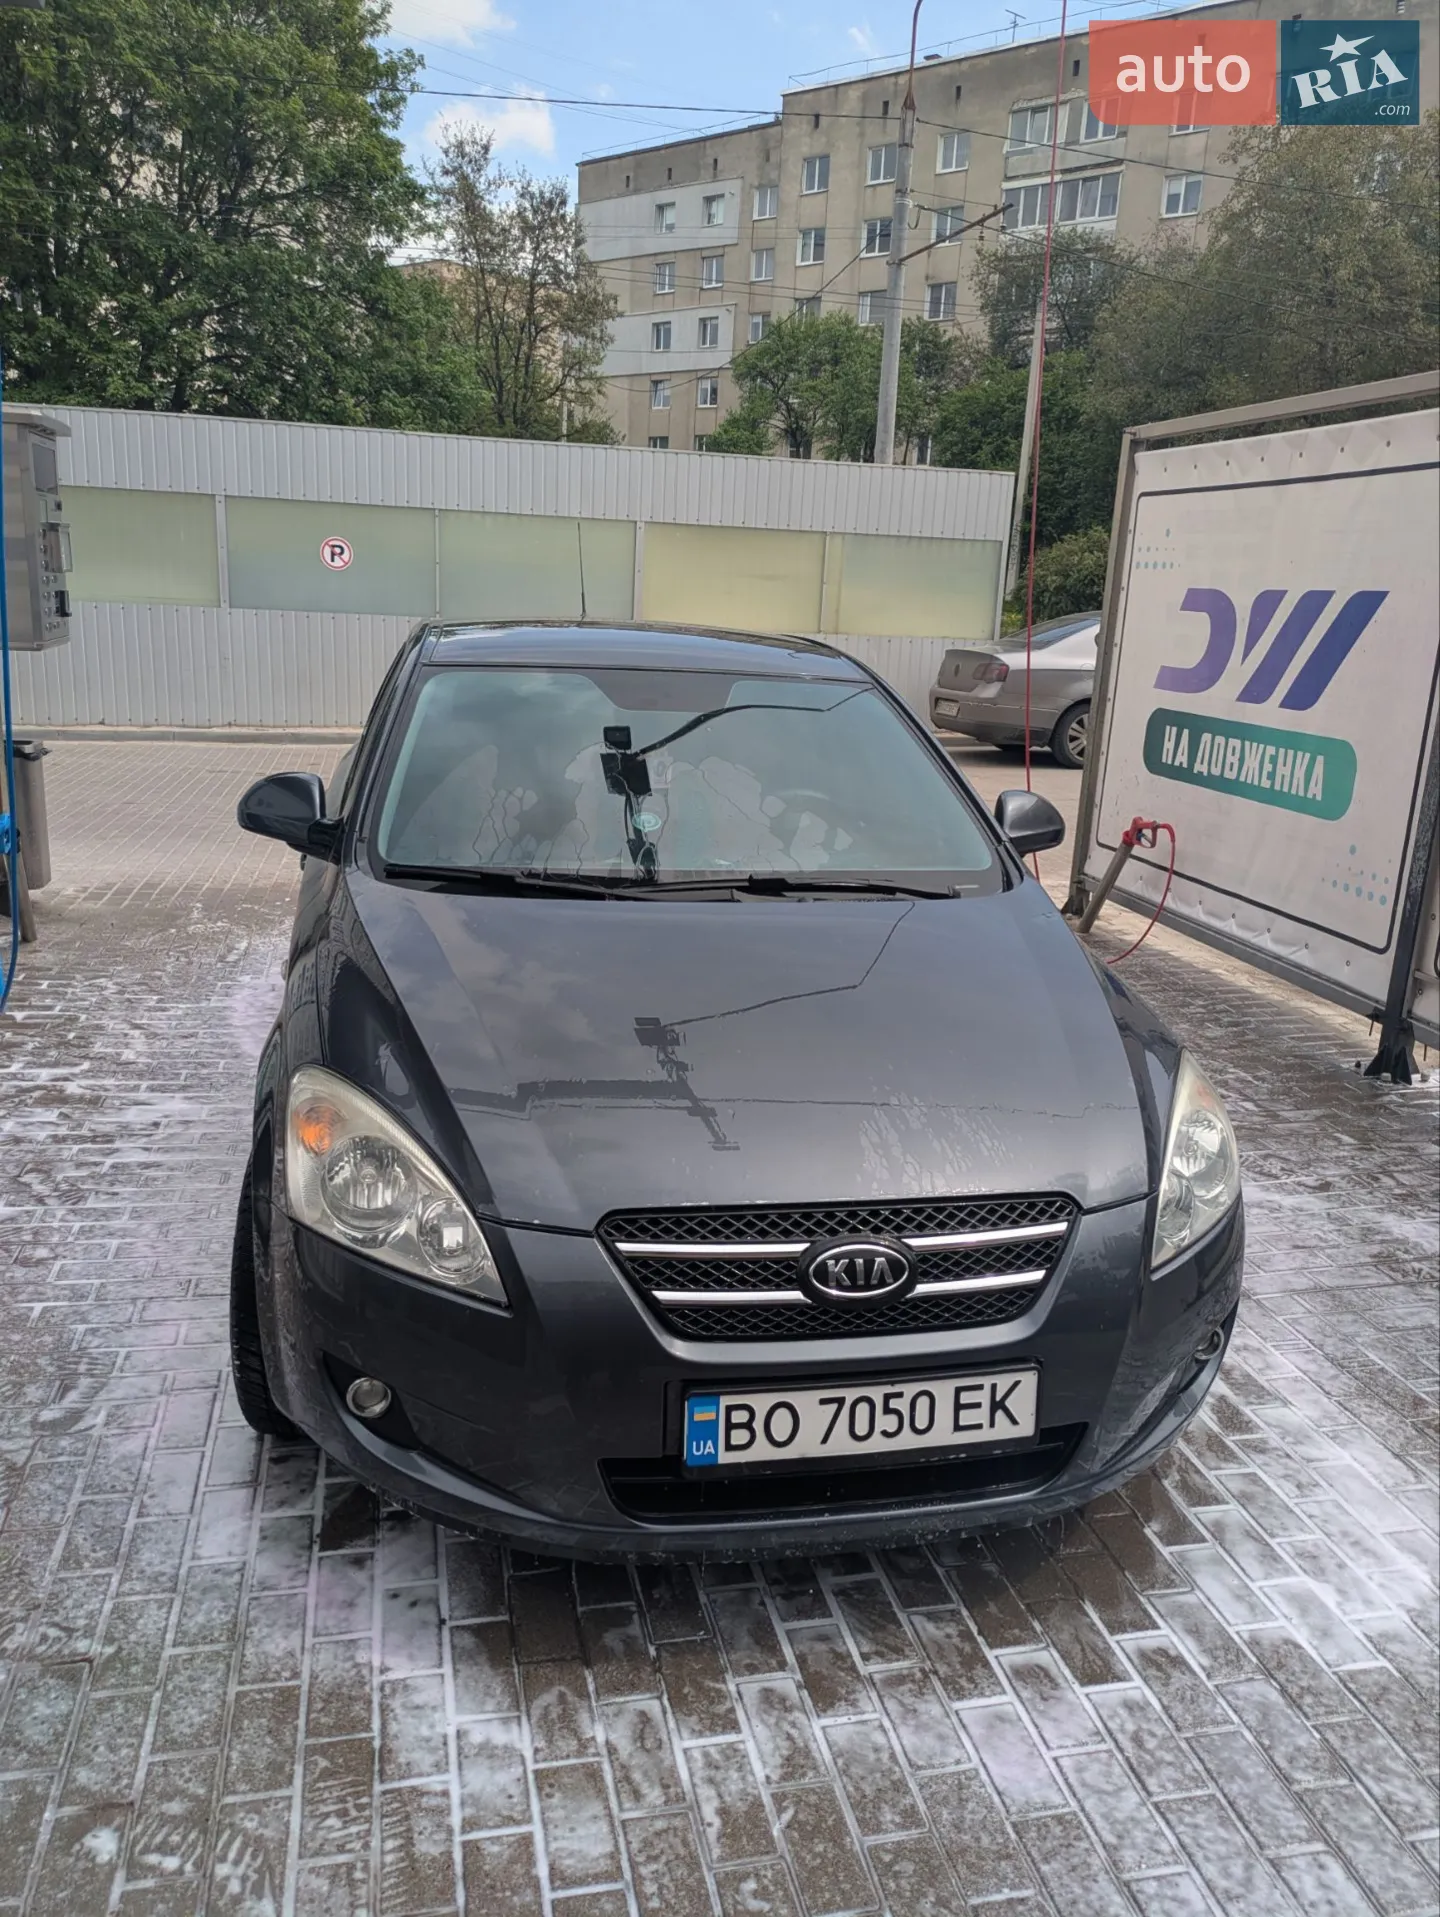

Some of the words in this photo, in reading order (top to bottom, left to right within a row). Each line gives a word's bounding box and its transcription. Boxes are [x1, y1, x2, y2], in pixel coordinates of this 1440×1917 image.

[330, 544, 345, 562] P
[1161, 725, 1190, 768] НА
[1194, 732, 1325, 801] ДОВЖЕНКА
[825, 1257, 894, 1287] KIA
[724, 1400, 801, 1452] BO
[818, 1389, 936, 1445] 7050
[953, 1379, 1023, 1434] EK
[692, 1440, 716, 1456] UA
